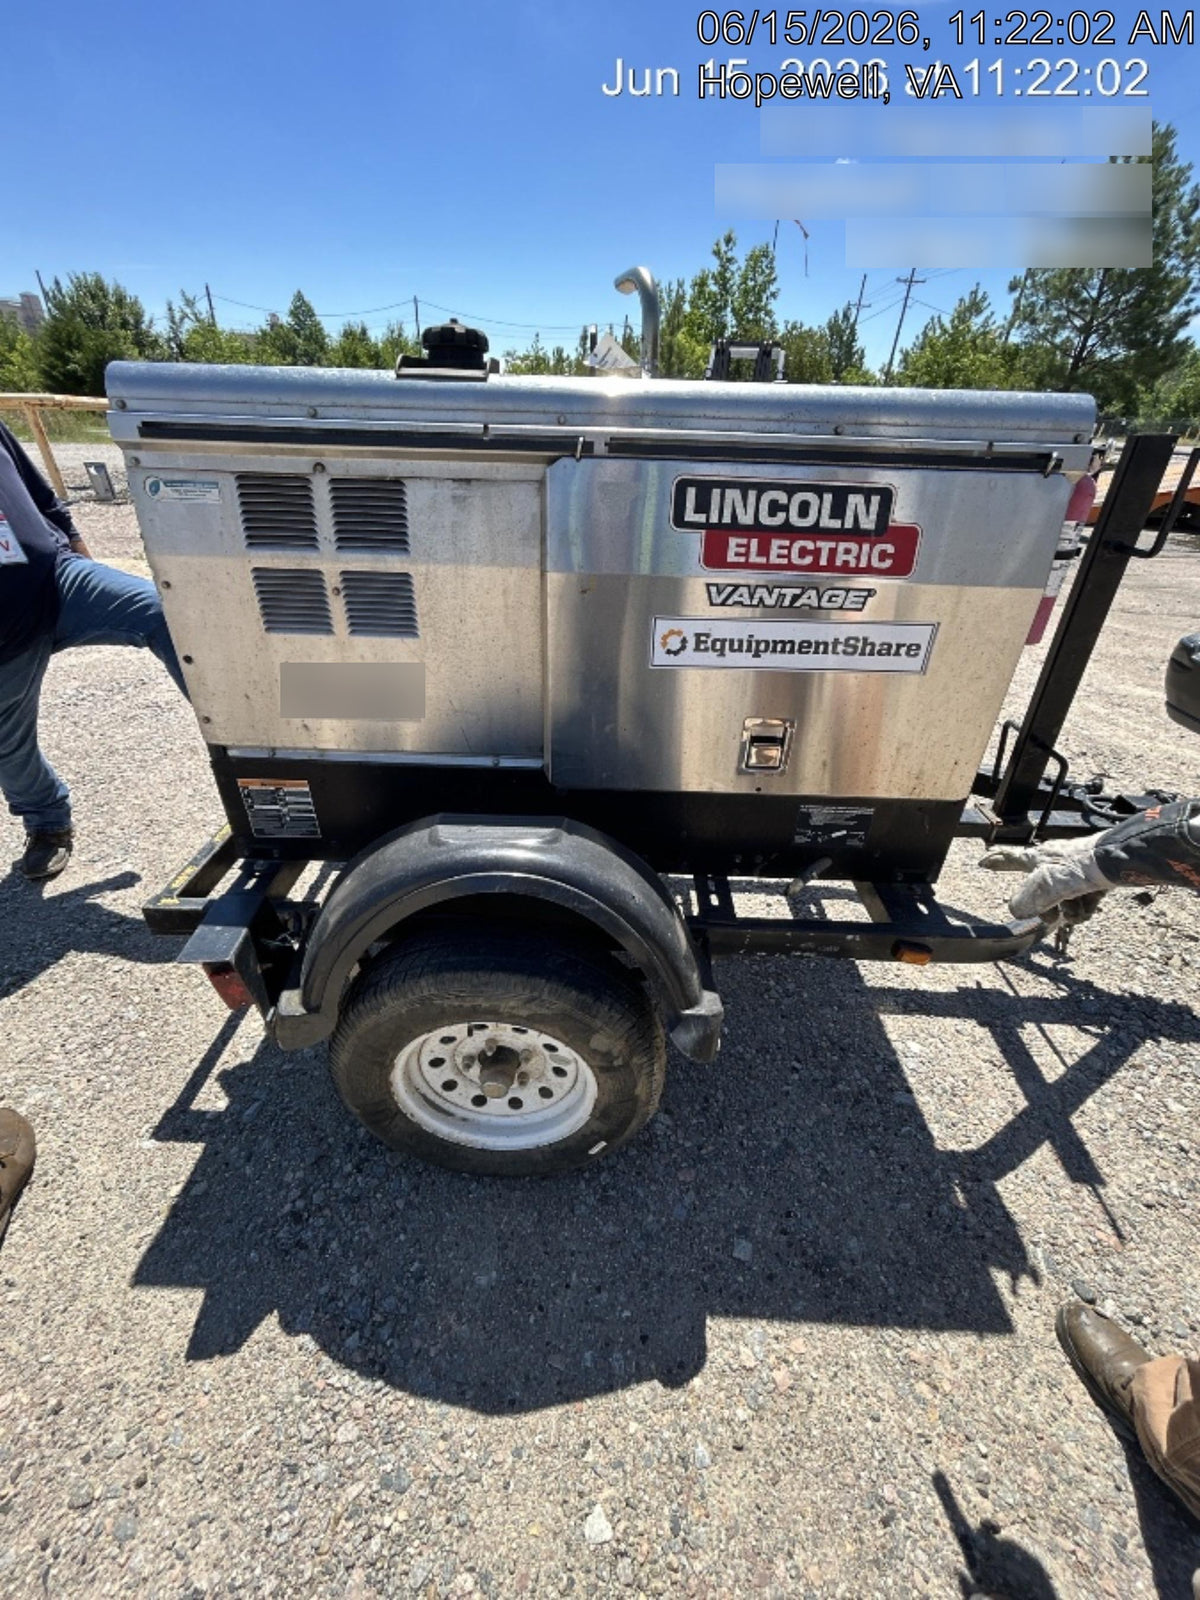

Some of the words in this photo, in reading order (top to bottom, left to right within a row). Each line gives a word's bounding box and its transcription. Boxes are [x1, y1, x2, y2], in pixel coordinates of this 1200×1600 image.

[683, 486, 881, 531] LINCOLN
[726, 536, 896, 569] ELECTRIC
[692, 631, 922, 659] EquipmentShare
